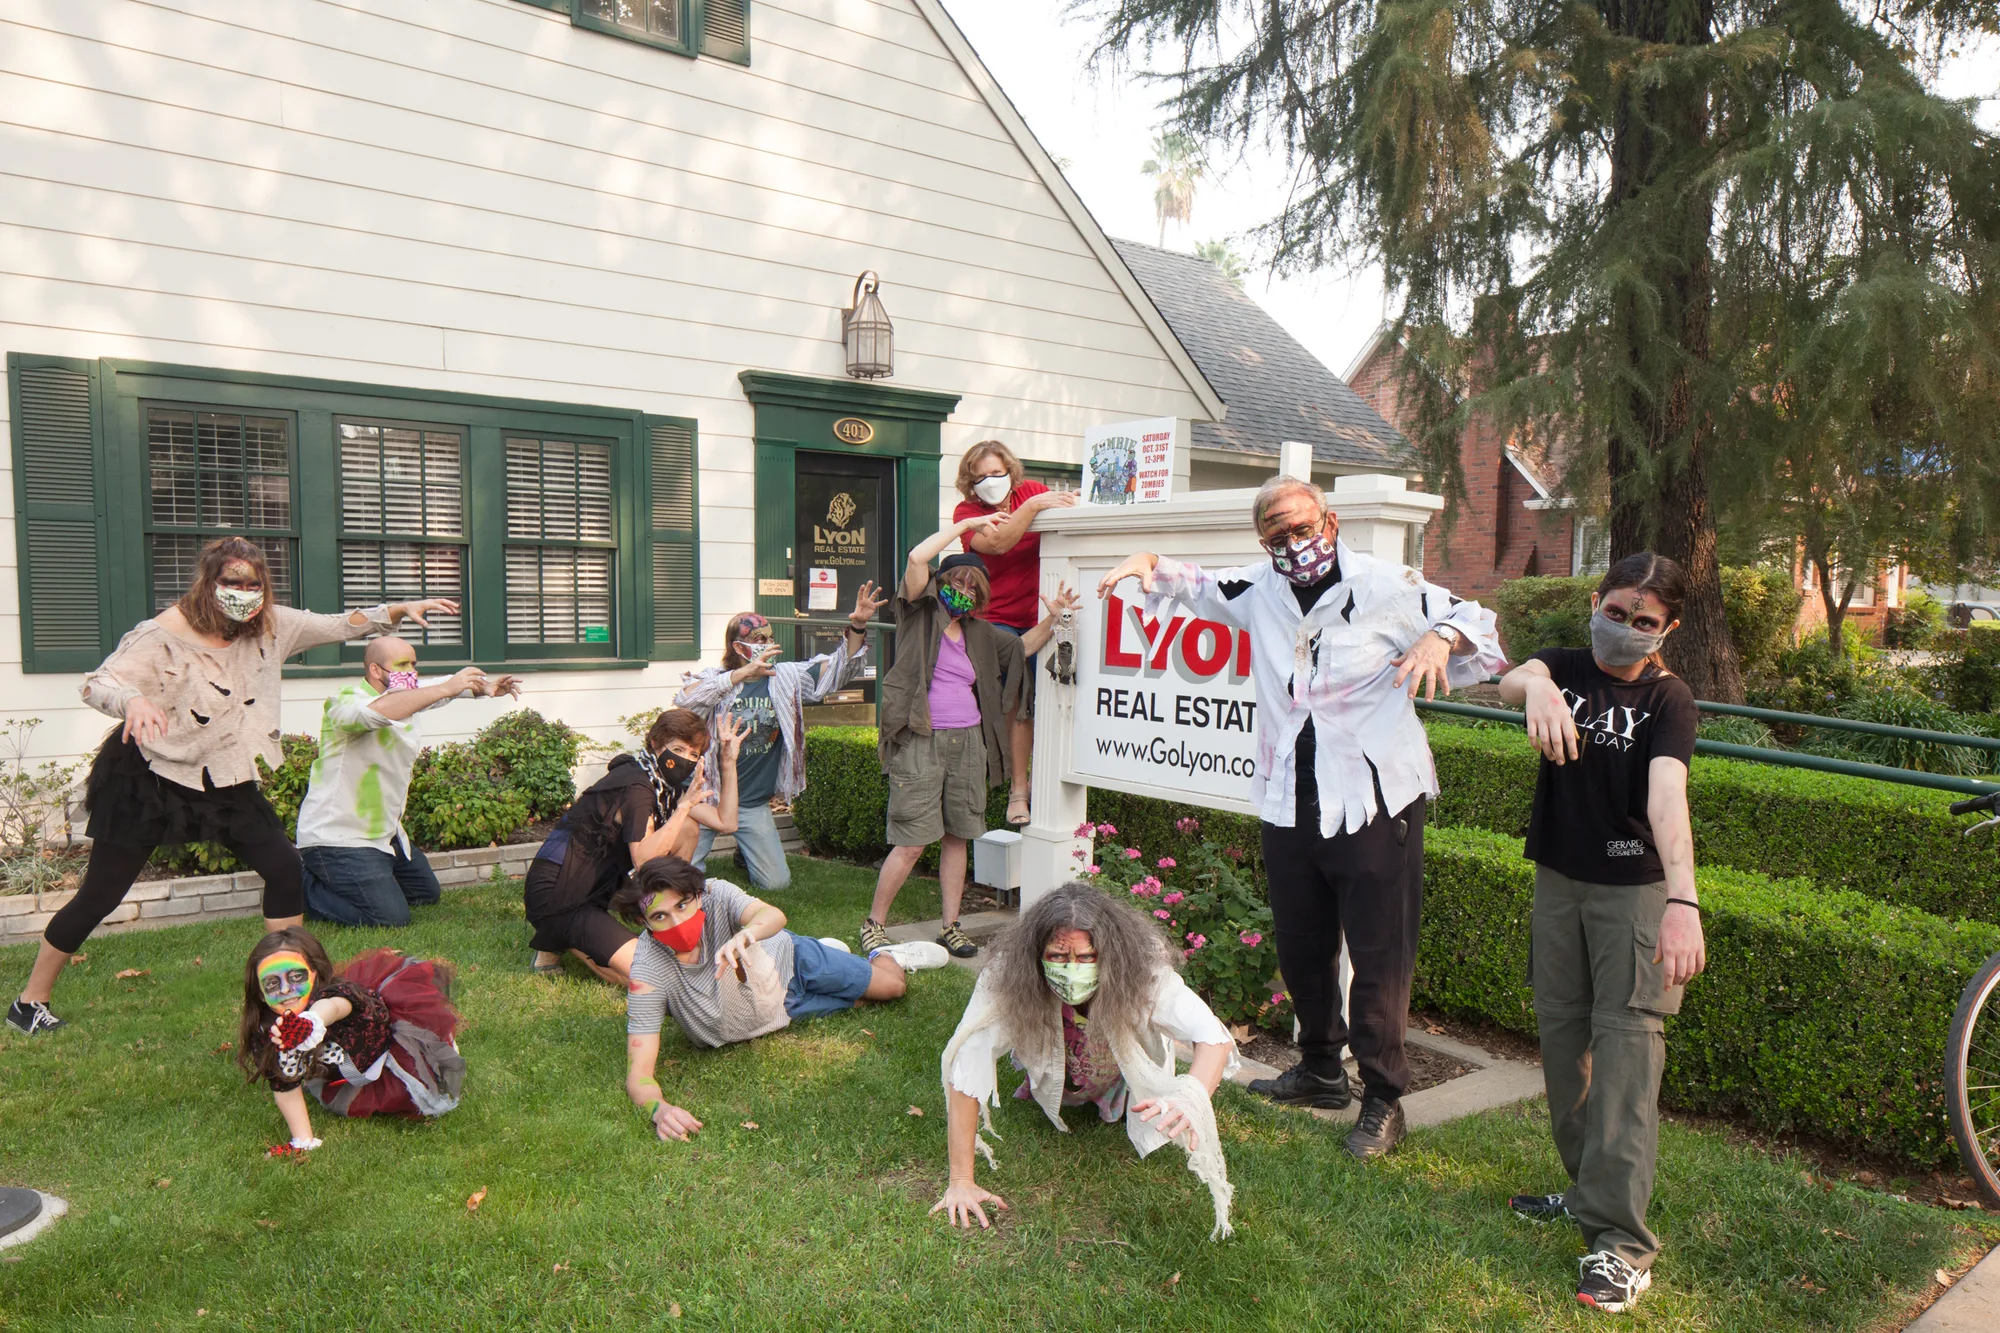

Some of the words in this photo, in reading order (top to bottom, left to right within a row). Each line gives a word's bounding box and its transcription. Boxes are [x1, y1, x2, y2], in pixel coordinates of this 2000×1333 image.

[842, 423, 865, 439] 401
[1142, 432, 1170, 443] SATURDAY
[1142, 444, 1154, 453] OCT.
[1155, 443, 1169, 452] 31ST
[1144, 454, 1165, 464] 12-3PM
[1139, 470, 1158, 479] WATCH
[1158, 469, 1169, 478] FOR
[1141, 480, 1165, 489] ZOMBIES
[1144, 490, 1160, 499] HERE!
[814, 524, 866, 545] LYON
[838, 546, 865, 554] ESTATE
[1096, 687, 1165, 723] REAL
[1175, 695, 1257, 733] ESTAT
[1594, 732, 1633, 752] DAY
[1096, 737, 1256, 778] www.GoLyon.co
[1606, 839, 1644, 849] GERARD
[1607, 849, 1644, 857] COSMETICS
